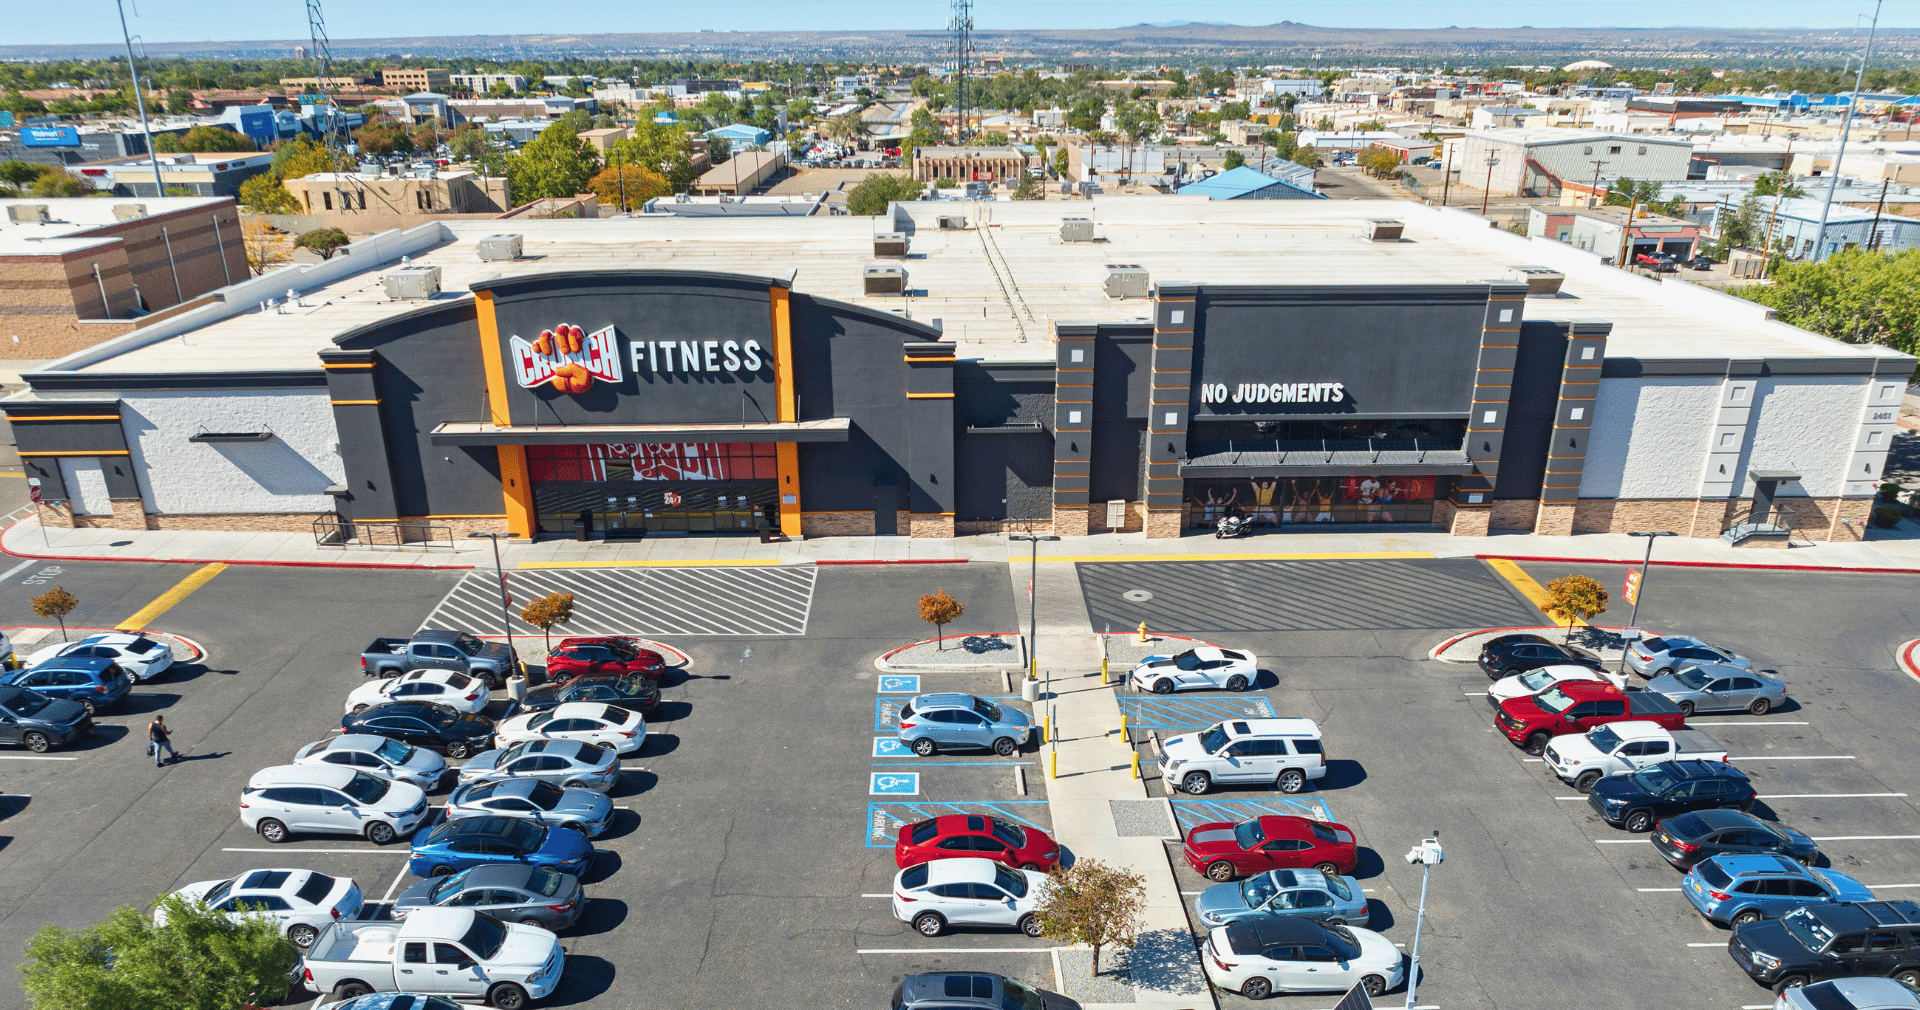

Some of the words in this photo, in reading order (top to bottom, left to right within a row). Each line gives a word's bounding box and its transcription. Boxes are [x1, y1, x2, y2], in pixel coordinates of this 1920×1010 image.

[629, 340, 762, 372] FITNESS
[1201, 383, 1228, 403] NO
[1232, 382, 1345, 403] JUDGMENTS
[22, 565, 64, 585] STOP
[873, 810, 886, 838] PARKING
